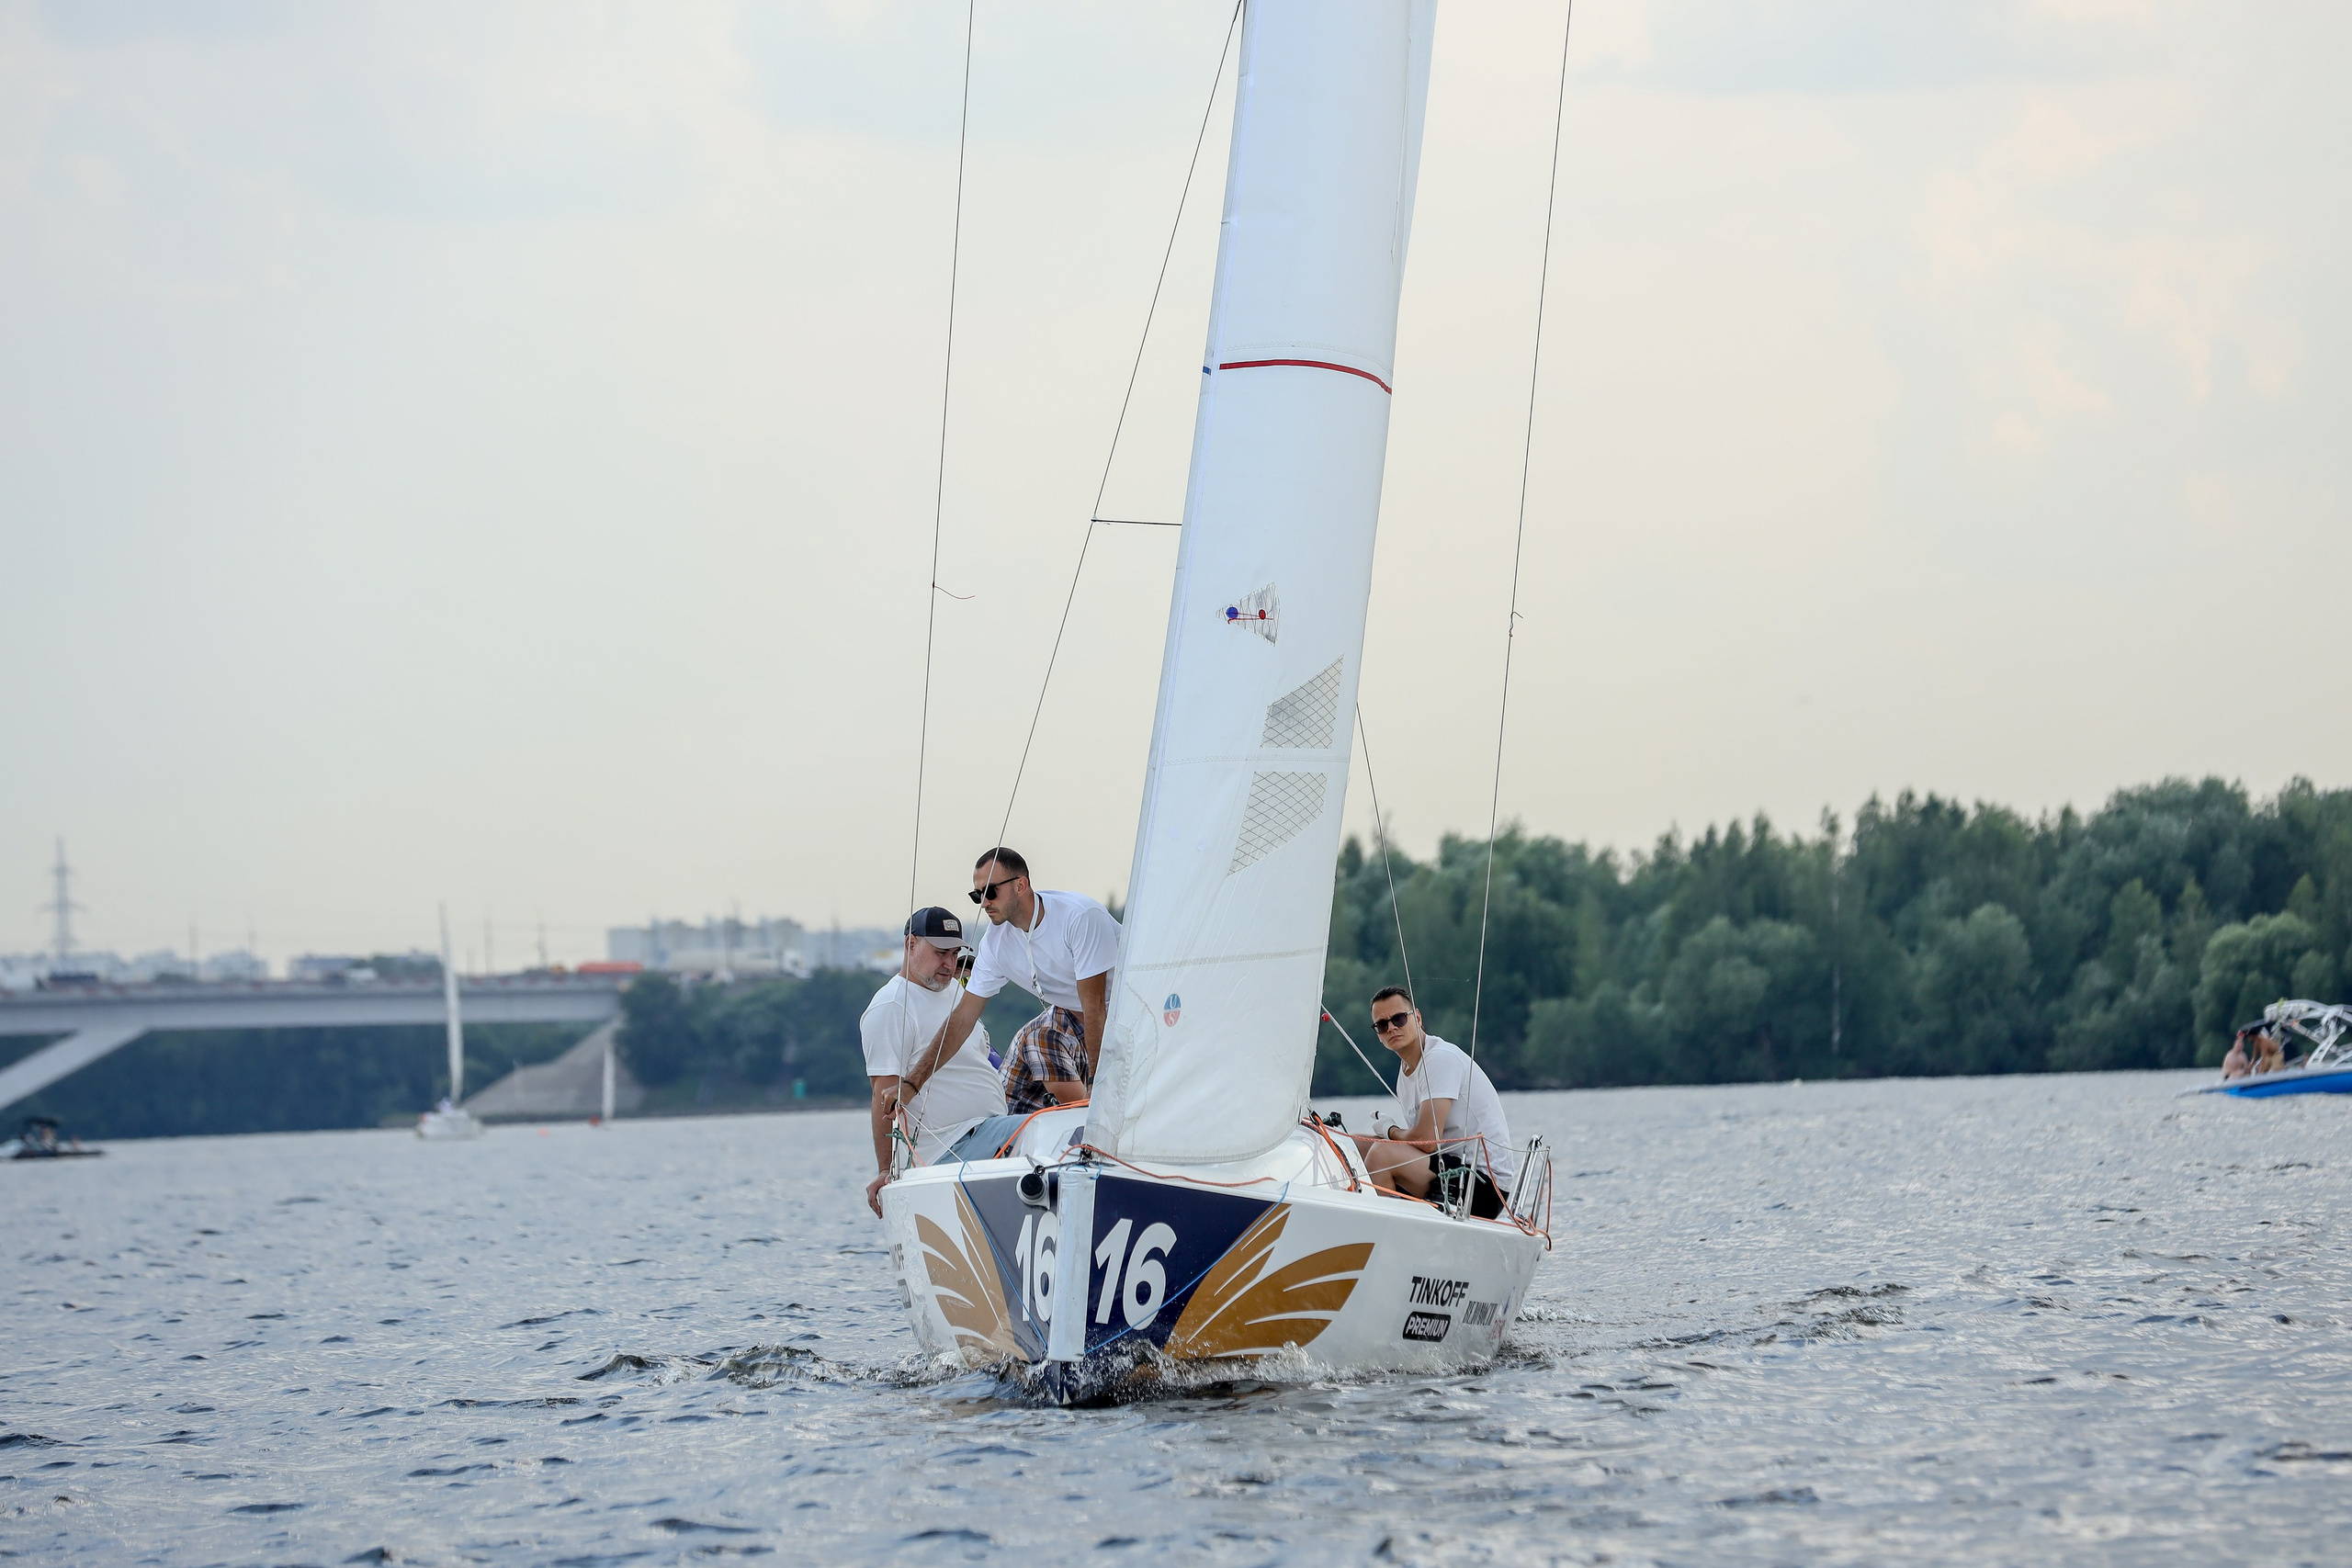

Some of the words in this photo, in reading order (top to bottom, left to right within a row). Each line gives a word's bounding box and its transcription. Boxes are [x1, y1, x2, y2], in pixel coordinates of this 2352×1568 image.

[1015, 1211, 1057, 1322] 16
[1095, 1217, 1178, 1330] 16
[1409, 1275, 1469, 1308] TINKOFF
[1405, 1315, 1449, 1338] PREMIUM
